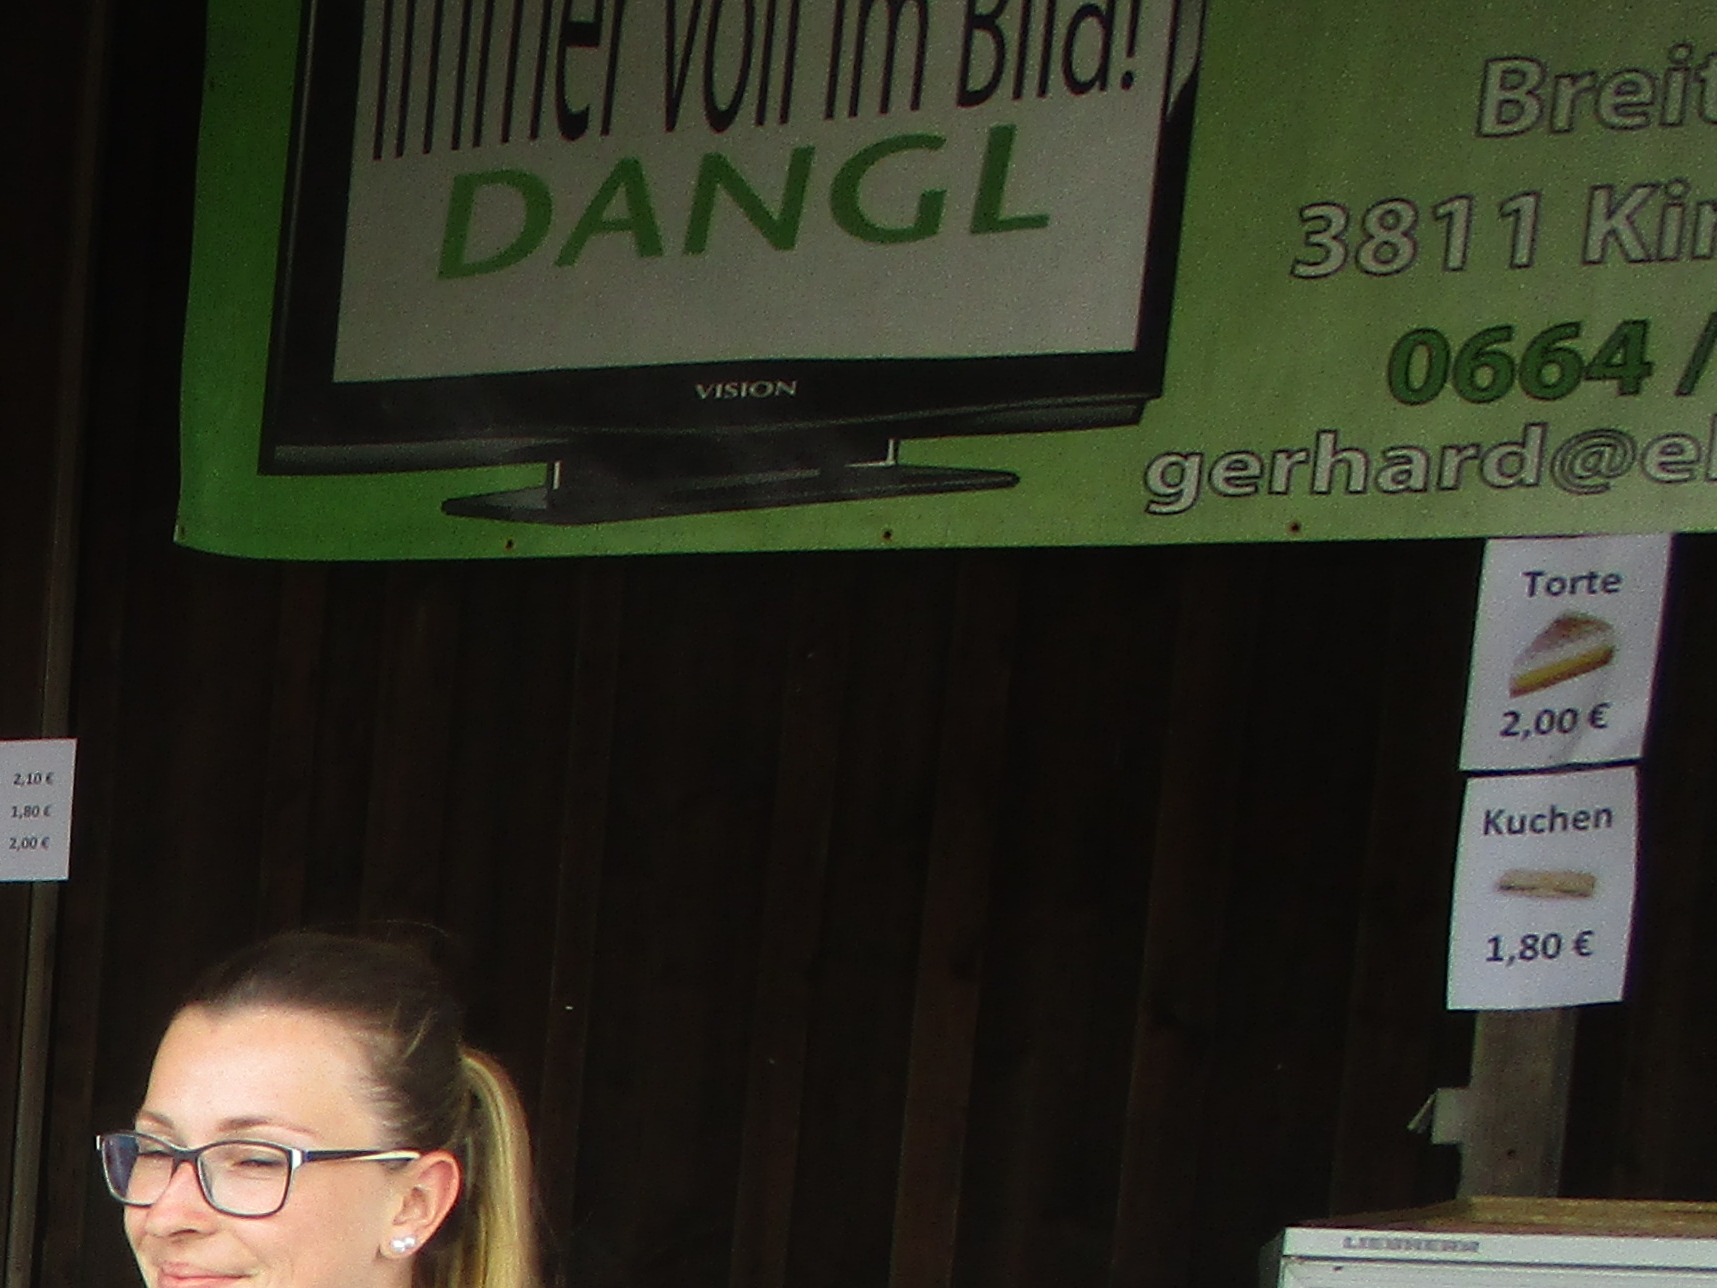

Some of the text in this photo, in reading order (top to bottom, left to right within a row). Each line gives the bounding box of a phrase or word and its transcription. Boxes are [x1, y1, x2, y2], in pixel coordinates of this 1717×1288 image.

[436, 124, 1051, 281] DANGL
[1289, 190, 1544, 280] 3811
[1387, 318, 1655, 406] 0664
[695, 380, 798, 400] VISION
[1521, 569, 1623, 598] Torte
[1499, 701, 1611, 741] 2,00 €
[13, 772, 43, 787] 2,10
[45, 771, 56, 786] €
[11, 804, 41, 820] 1,80
[42, 805, 52, 818] €
[1481, 806, 1615, 837] Kuchen
[8, 836, 38, 851] 2,00
[39, 836, 51, 850] €
[1485, 929, 1596, 968] 1,80 €
